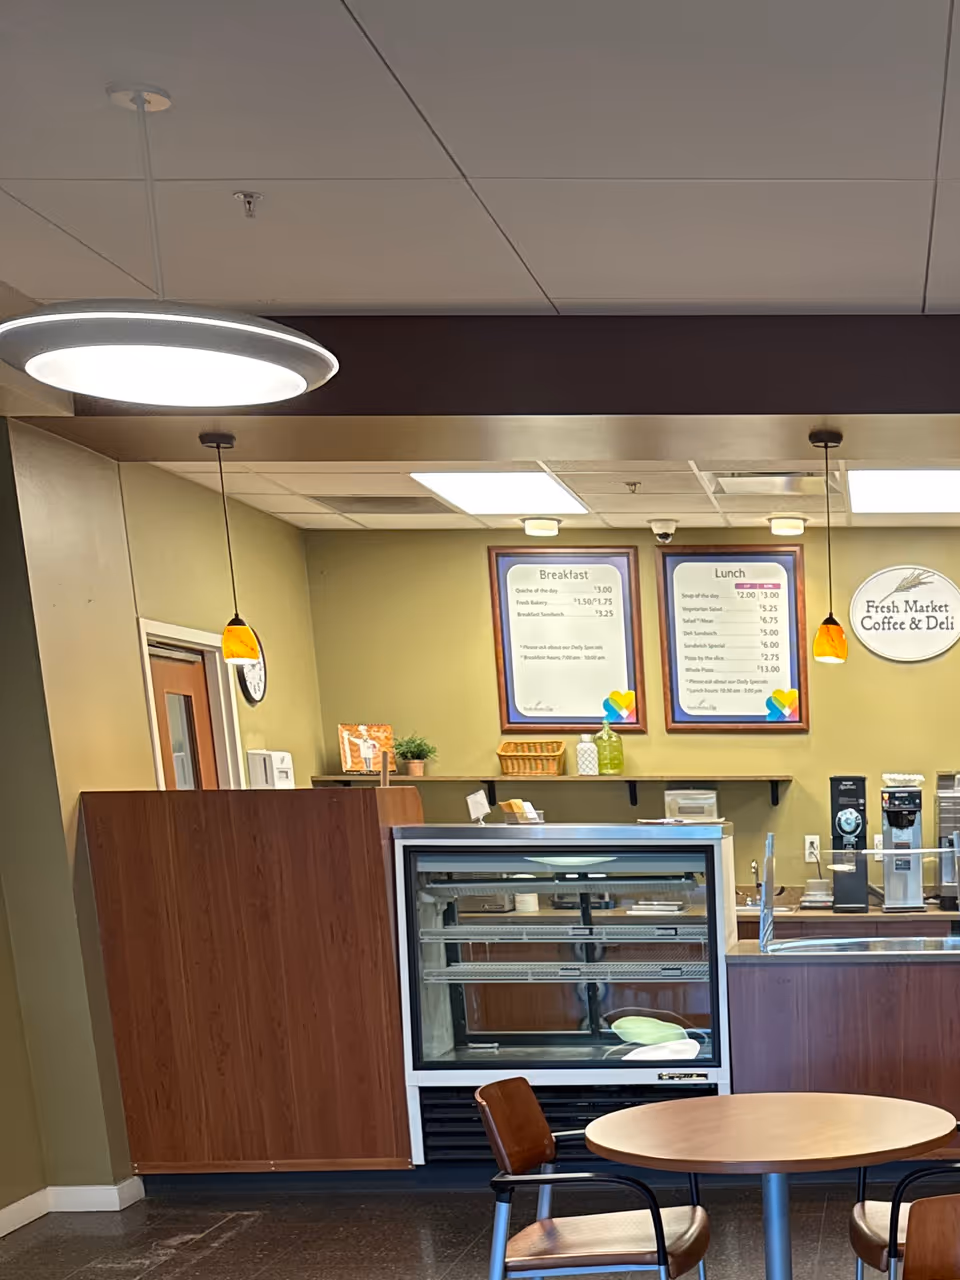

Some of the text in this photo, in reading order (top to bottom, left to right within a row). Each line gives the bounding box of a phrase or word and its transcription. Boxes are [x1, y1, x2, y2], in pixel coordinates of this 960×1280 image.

[539, 569, 589, 580] Breakfast
[715, 568, 746, 578] Lunch
[594, 586, 612, 594] $3.00
[737, 591, 756, 599] $2.00
[761, 591, 780, 599] $3.00
[760, 604, 778, 612] $5.25
[865, 599, 949, 613] Fresh Market
[595, 609, 614, 617] $3.25
[760, 616, 778, 624] $6.75
[860, 615, 955, 631] Coffee & Deli
[760, 628, 779, 636] $5.00
[761, 641, 780, 649] $6.00
[761, 653, 780, 661] $2.75
[757, 665, 780, 673] $13.00
